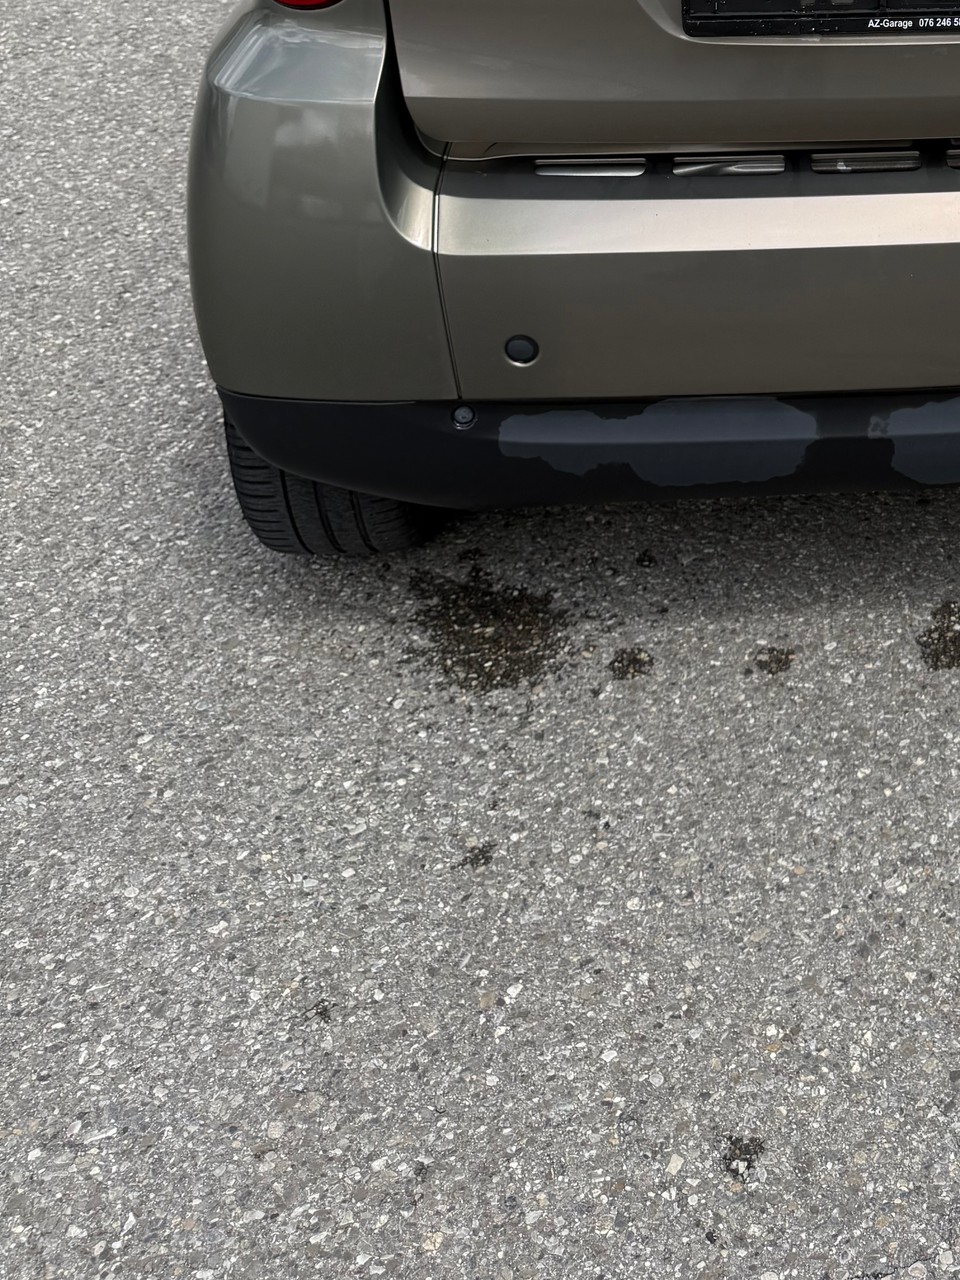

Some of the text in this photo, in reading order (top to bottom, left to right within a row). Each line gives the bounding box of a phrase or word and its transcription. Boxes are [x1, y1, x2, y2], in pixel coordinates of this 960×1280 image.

[867, 19, 913, 29] AZ-Garage
[918, 18, 934, 27] 076
[936, 18, 952, 27] 246
